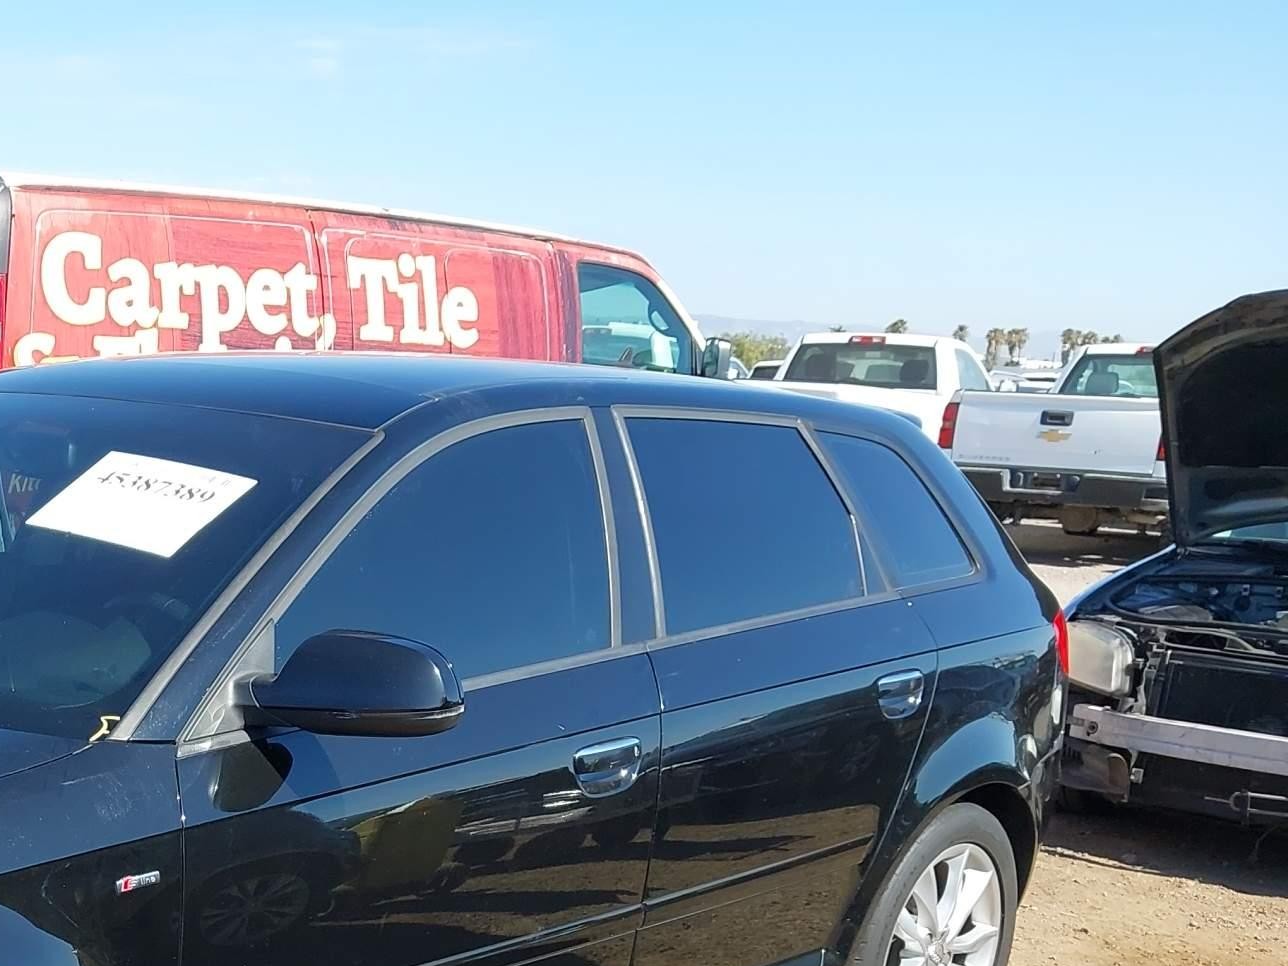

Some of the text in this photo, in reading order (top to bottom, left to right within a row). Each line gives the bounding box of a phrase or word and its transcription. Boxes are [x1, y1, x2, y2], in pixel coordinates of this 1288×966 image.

[41, 231, 480, 352] Carpet, Tile
[98, 471, 216, 502] 45387389
